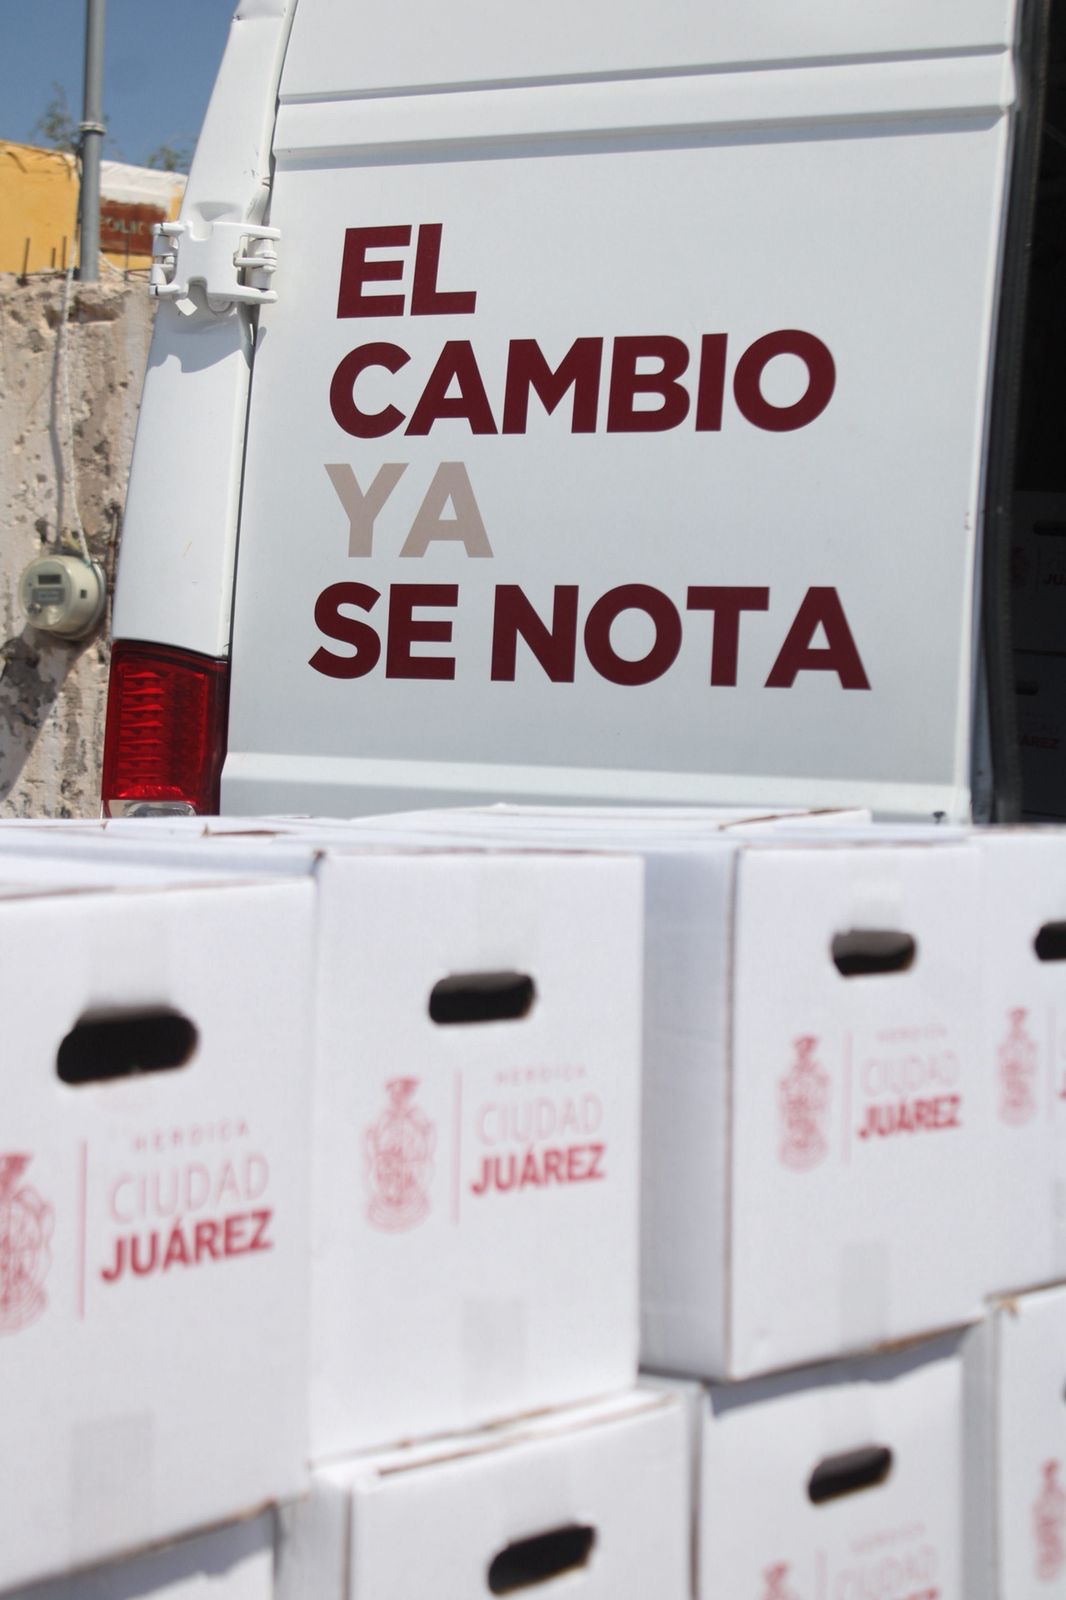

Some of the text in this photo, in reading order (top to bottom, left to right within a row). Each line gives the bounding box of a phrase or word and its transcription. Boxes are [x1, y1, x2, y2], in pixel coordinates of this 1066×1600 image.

[336, 222, 477, 319] EL
[329, 328, 836, 438] CAMBIO
[324, 461, 494, 558] YA
[308, 581, 871, 690] SE NOTA
[477, 1091, 605, 1147] CIUDAD
[860, 1094, 961, 1139] JUÁREZ
[109, 1151, 270, 1223] CIUDAD
[470, 1142, 606, 1196] JUÁREZ
[100, 1208, 273, 1284] JUÁREZ
